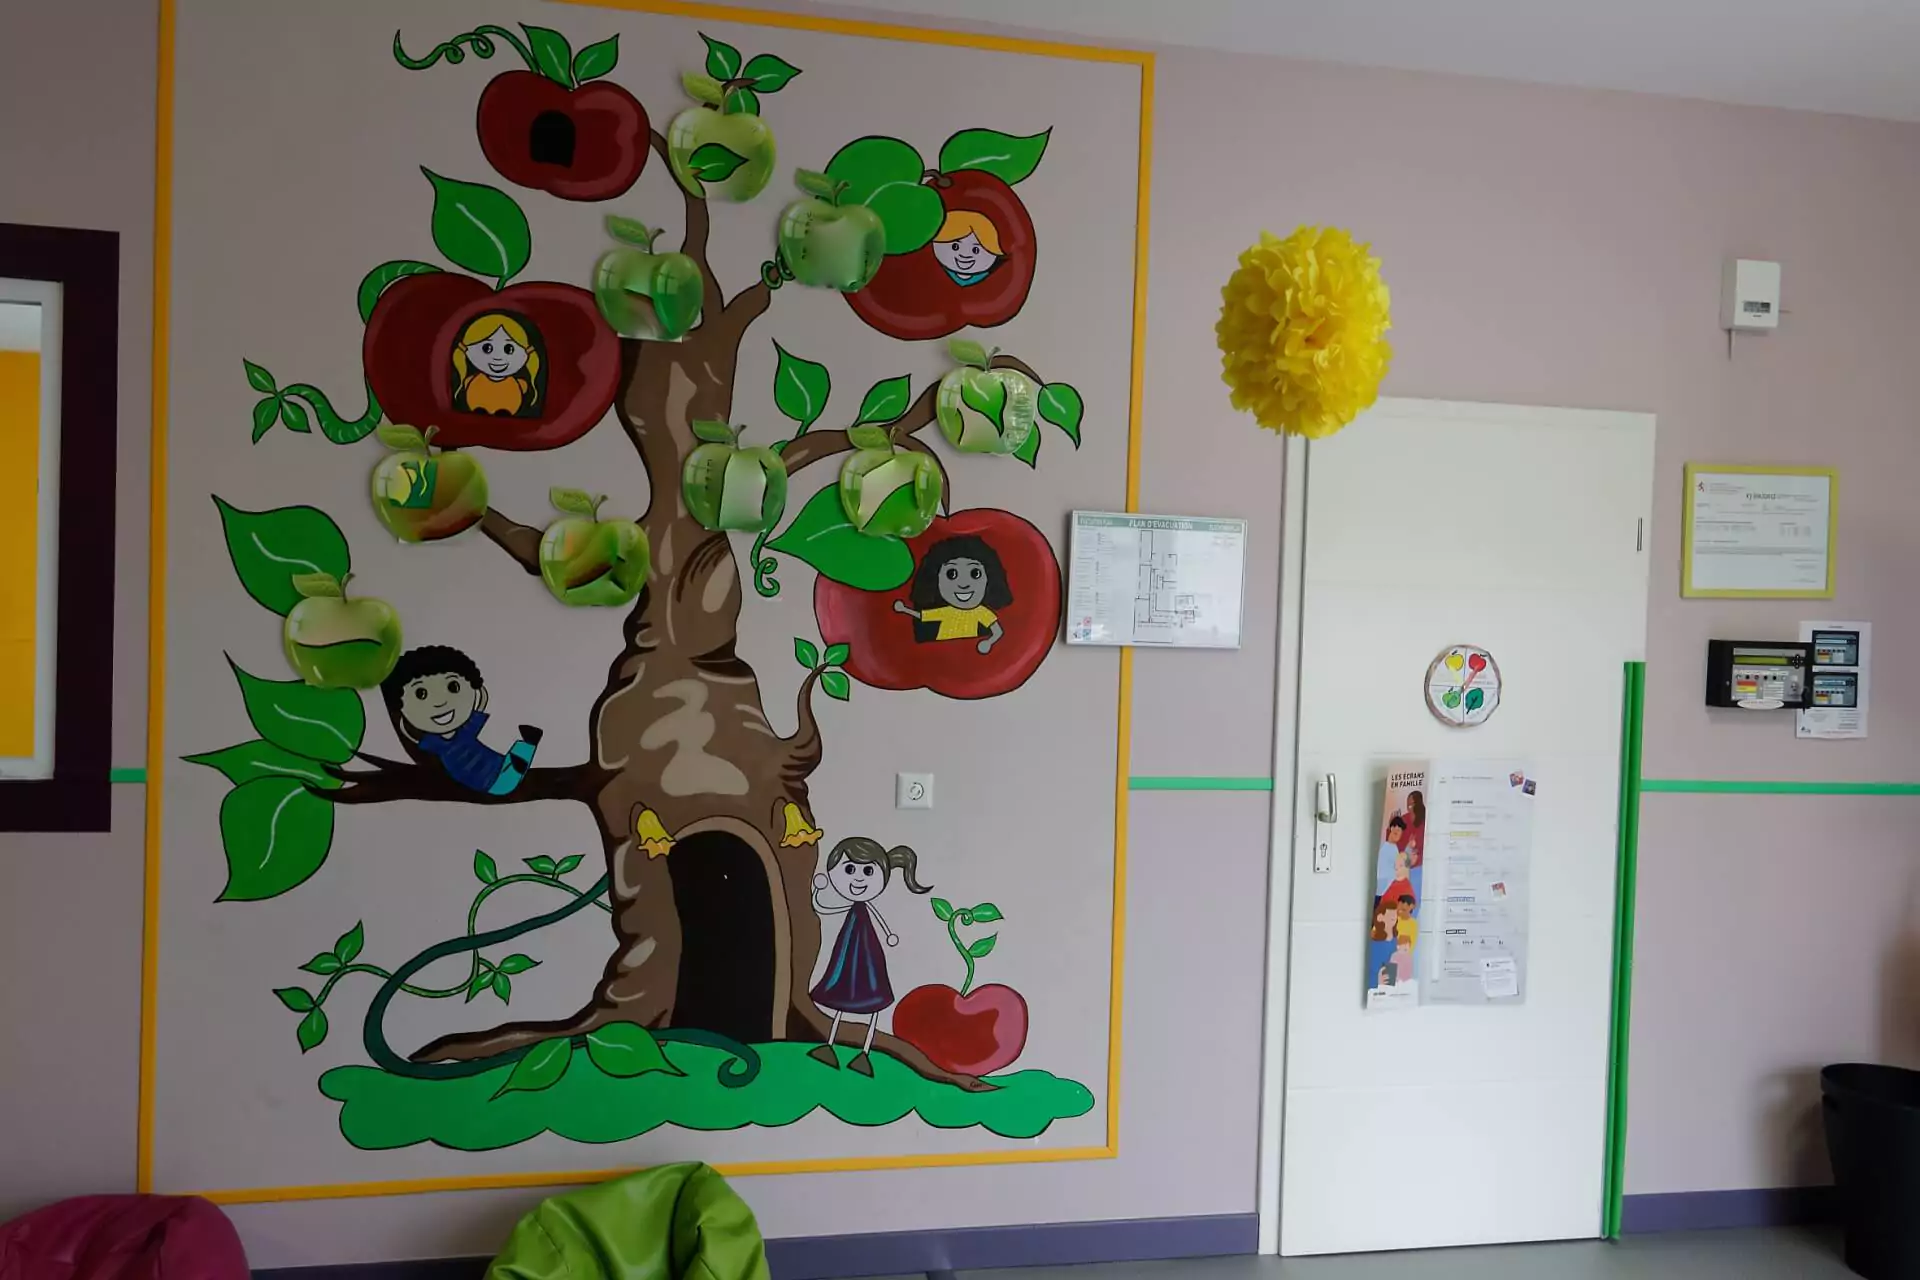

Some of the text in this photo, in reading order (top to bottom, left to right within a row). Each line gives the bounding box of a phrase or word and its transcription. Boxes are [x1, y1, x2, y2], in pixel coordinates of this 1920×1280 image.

[1129, 519, 1146, 528] PLAN
[1391, 773, 1402, 781] LES
[1399, 780, 1422, 788] FAMILLE
